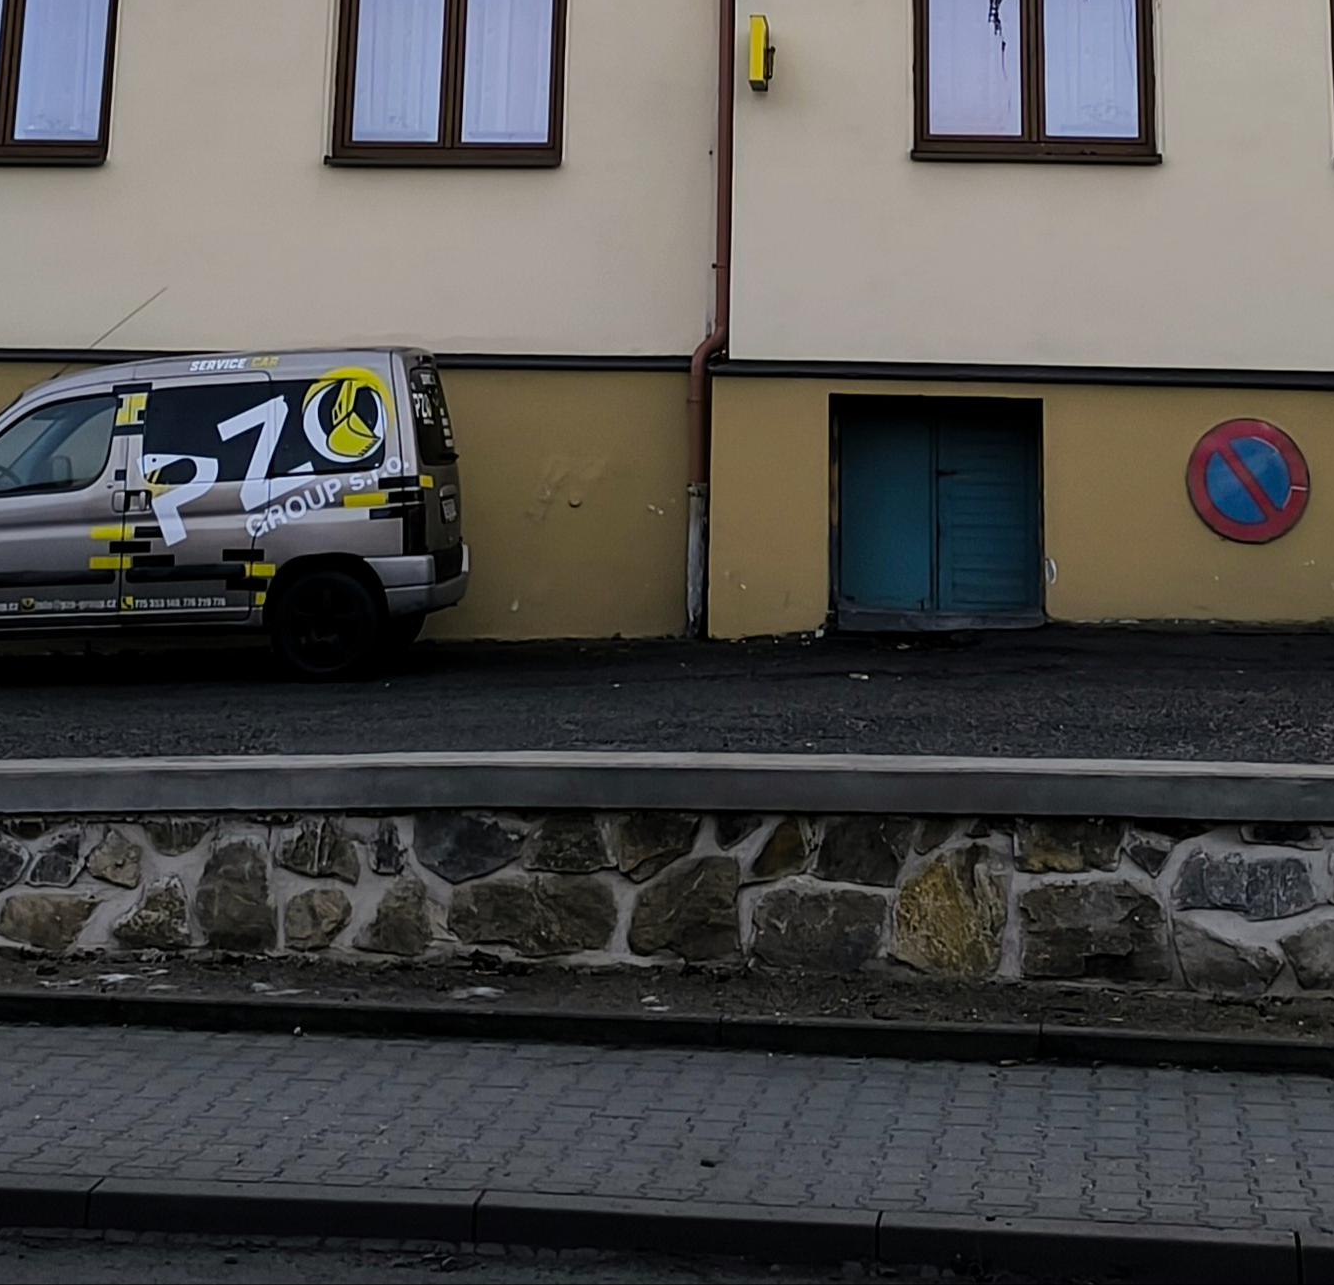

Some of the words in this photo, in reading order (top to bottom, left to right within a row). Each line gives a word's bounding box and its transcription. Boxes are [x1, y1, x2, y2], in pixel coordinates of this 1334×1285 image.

[189, 357, 247, 372] SERVICE
[250, 356, 280, 369] CAR
[244, 476, 342, 540] GROUP
[350, 455, 410, 492] s.r.o.
